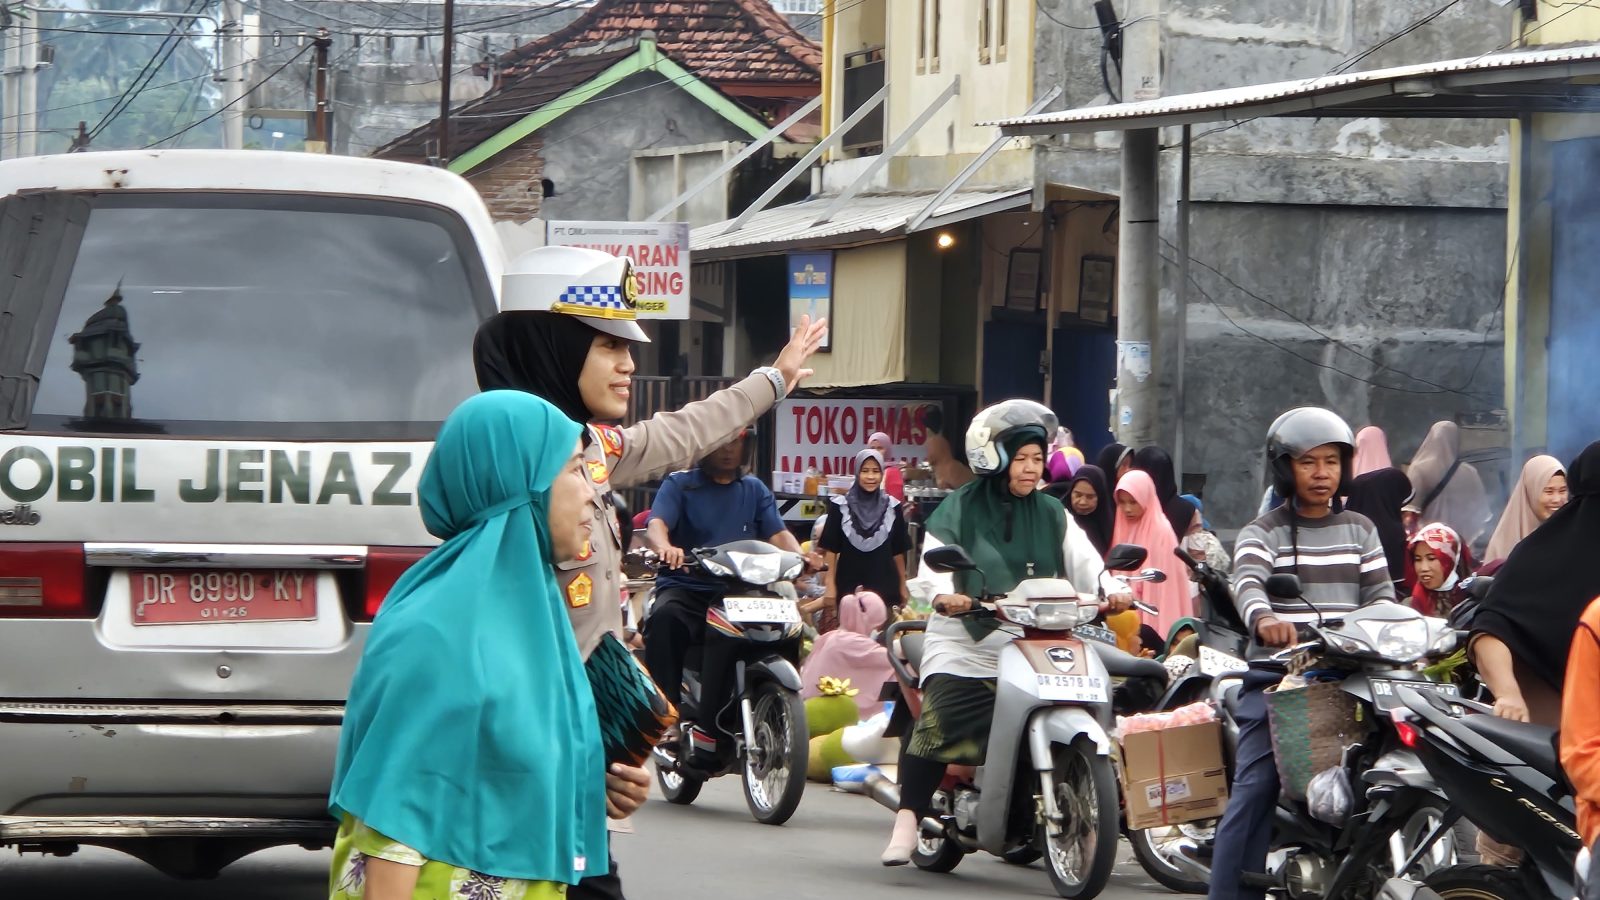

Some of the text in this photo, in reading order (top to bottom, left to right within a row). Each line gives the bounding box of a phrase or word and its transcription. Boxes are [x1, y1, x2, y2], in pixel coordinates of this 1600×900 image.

[636, 272, 683, 295] SING
[792, 406, 928, 445] TOKO EMAS
[143, 573, 176, 604] DR
[274, 571, 305, 601] KY
[1037, 675, 1051, 686] DR
